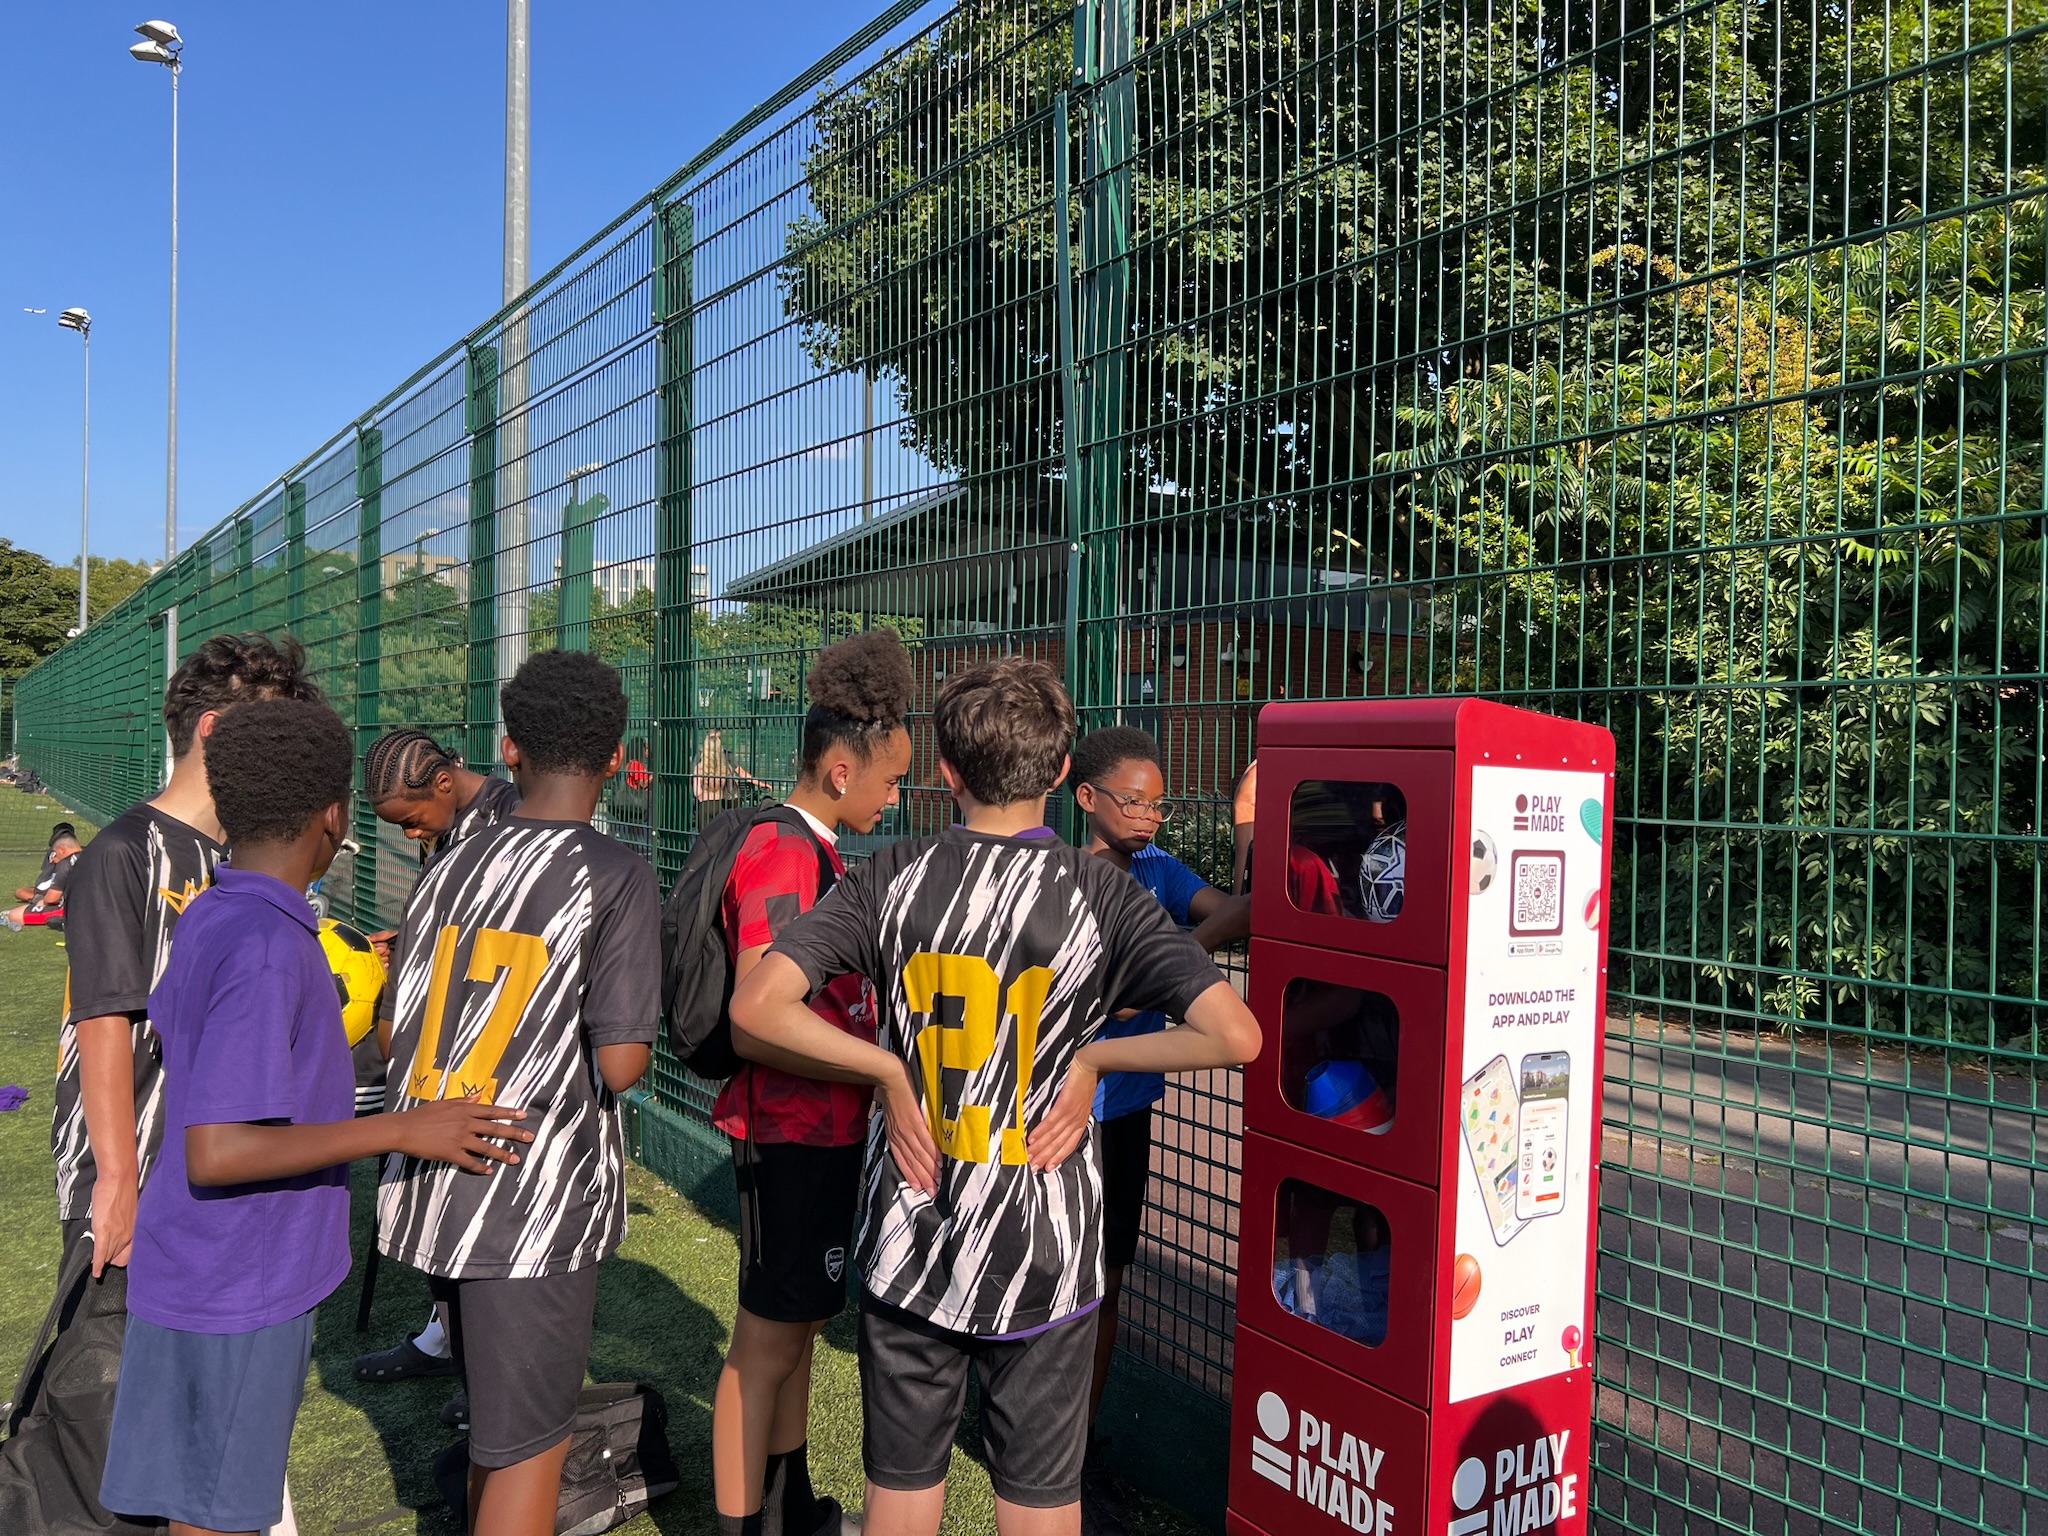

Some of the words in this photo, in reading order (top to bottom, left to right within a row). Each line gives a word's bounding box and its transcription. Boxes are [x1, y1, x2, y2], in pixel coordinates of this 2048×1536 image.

[1532, 795, 1562, 813] PLAY
[1531, 814, 1565, 832] MADE
[1488, 990, 1553, 1006] DOWNLOAD
[1555, 988, 1576, 1002] THE
[407, 925, 549, 1105] 17
[1492, 1014, 1516, 1029] APP
[1516, 1012, 1541, 1027] AND
[1542, 1010, 1571, 1025] PLAY
[902, 952, 1056, 1165] 21
[1500, 1304, 1541, 1322] DISCOVER
[1504, 1324, 1536, 1346] PLAY
[1499, 1349, 1538, 1367] CONNECT
[1299, 1409, 1385, 1491] PLAY
[1495, 1429, 1571, 1495] PLAY
[1297, 1455, 1395, 1536] MADE
[1492, 1473, 1578, 1536] MADE
